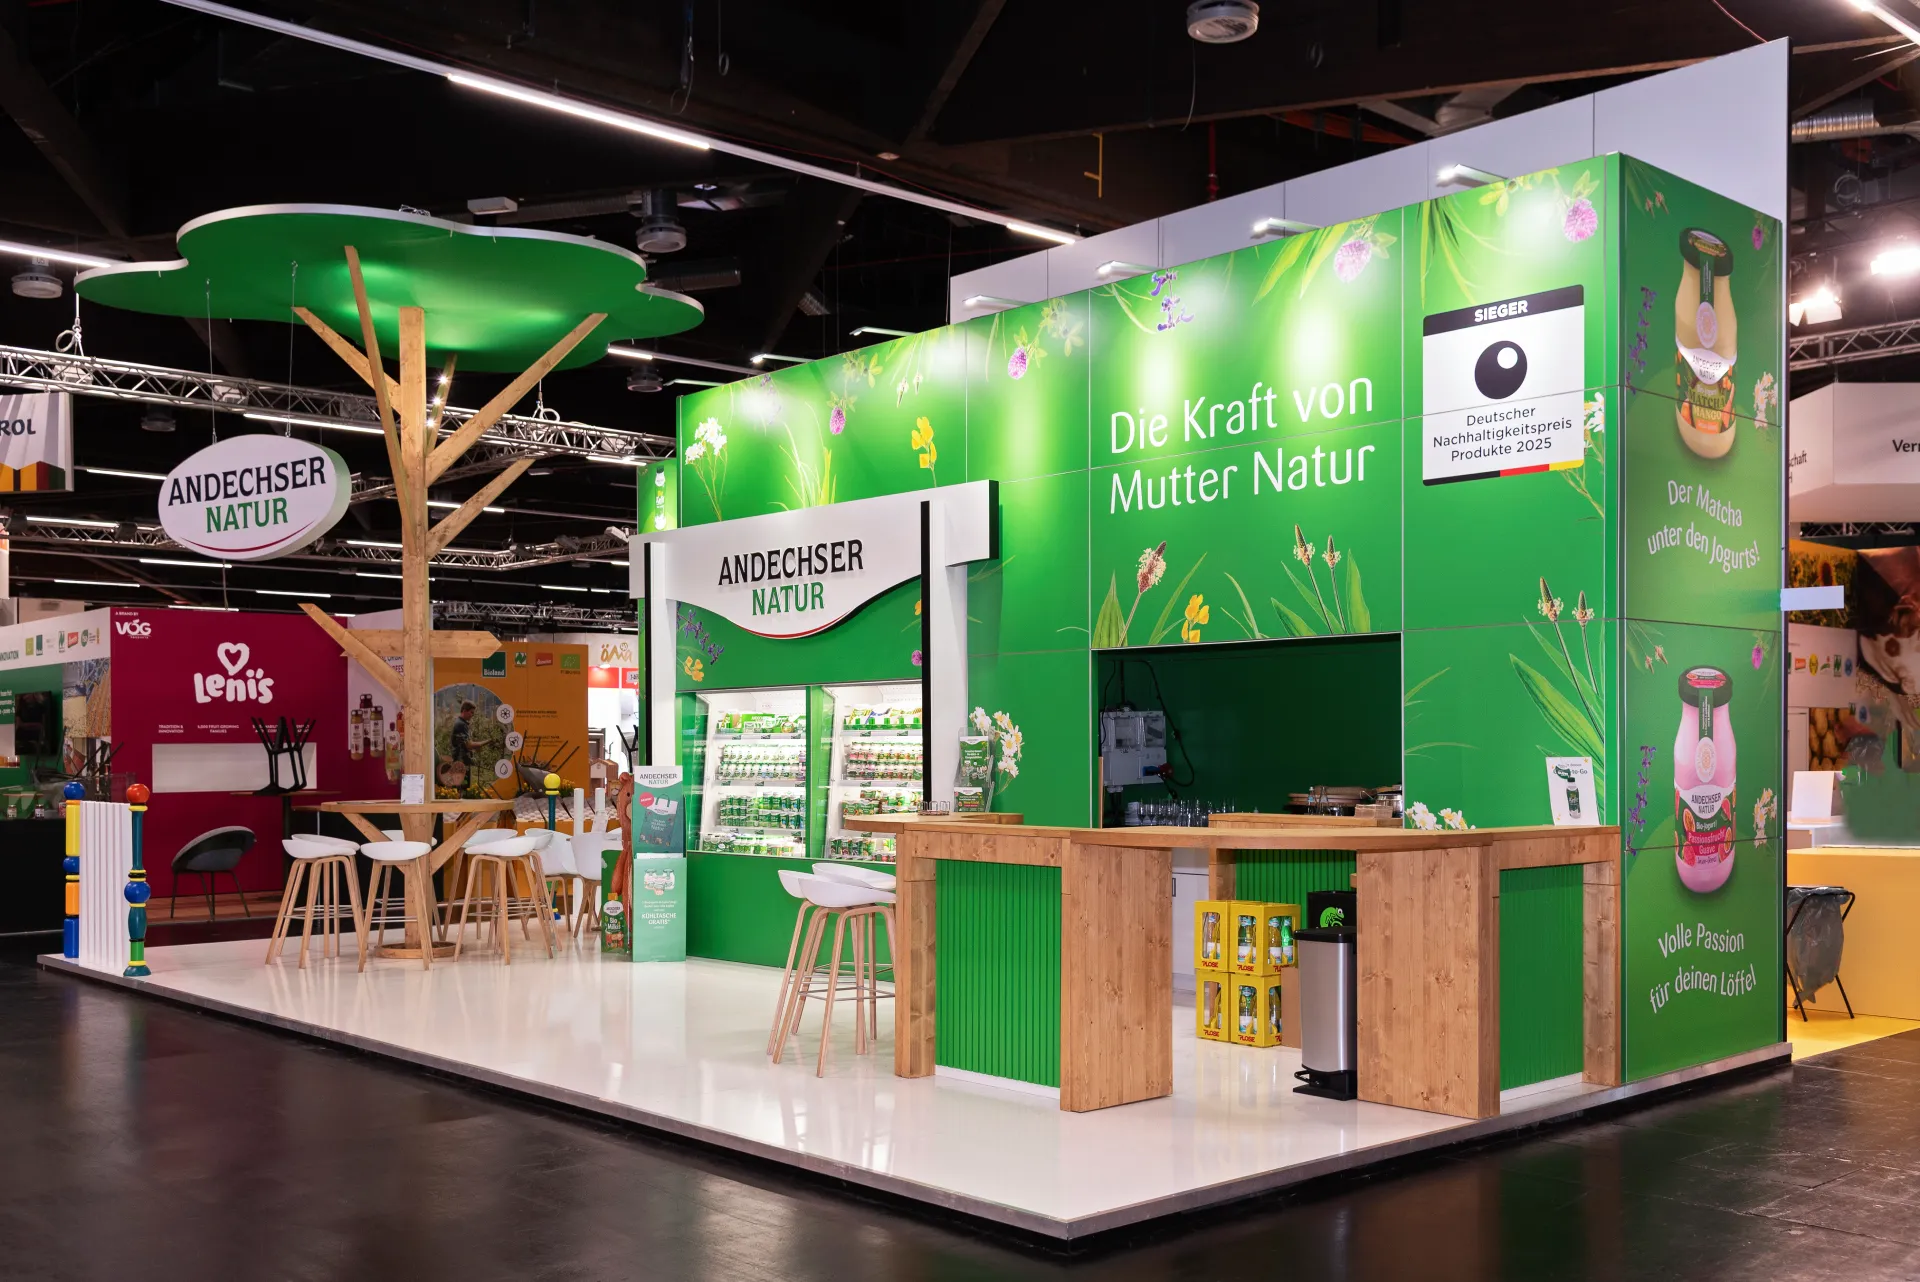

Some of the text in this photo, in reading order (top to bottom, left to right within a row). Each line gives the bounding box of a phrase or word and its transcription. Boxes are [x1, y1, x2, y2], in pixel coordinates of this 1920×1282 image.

[1474, 300, 1528, 322] SIEGER
[1111, 377, 1373, 454] Die Kraft von
[1466, 407, 1536, 426] Deutscher
[1688, 389, 1726, 409] MATCHA
[1433, 417, 1572, 448] Nachhaltigkeitspreis
[1451, 437, 1552, 462] Produkte 2025
[168, 455, 326, 506] ANDECHSER
[1110, 444, 1375, 514] Mutter Natur
[205, 497, 288, 533] NATUR
[1667, 480, 1742, 527] Der Matcha
[717, 538, 864, 586] ANDECHSER
[1647, 522, 1760, 574] unter den Jogurts!
[751, 581, 825, 616] NATUR
[193, 668, 275, 704] Leni's
[483, 668, 505, 676] Bioland
[1691, 792, 1722, 805] ANDECHSER
[1699, 804, 1715, 814] NATUR
[1657, 923, 1744, 958] Volle Passion
[1650, 963, 1757, 1014] für deinen Löffel
